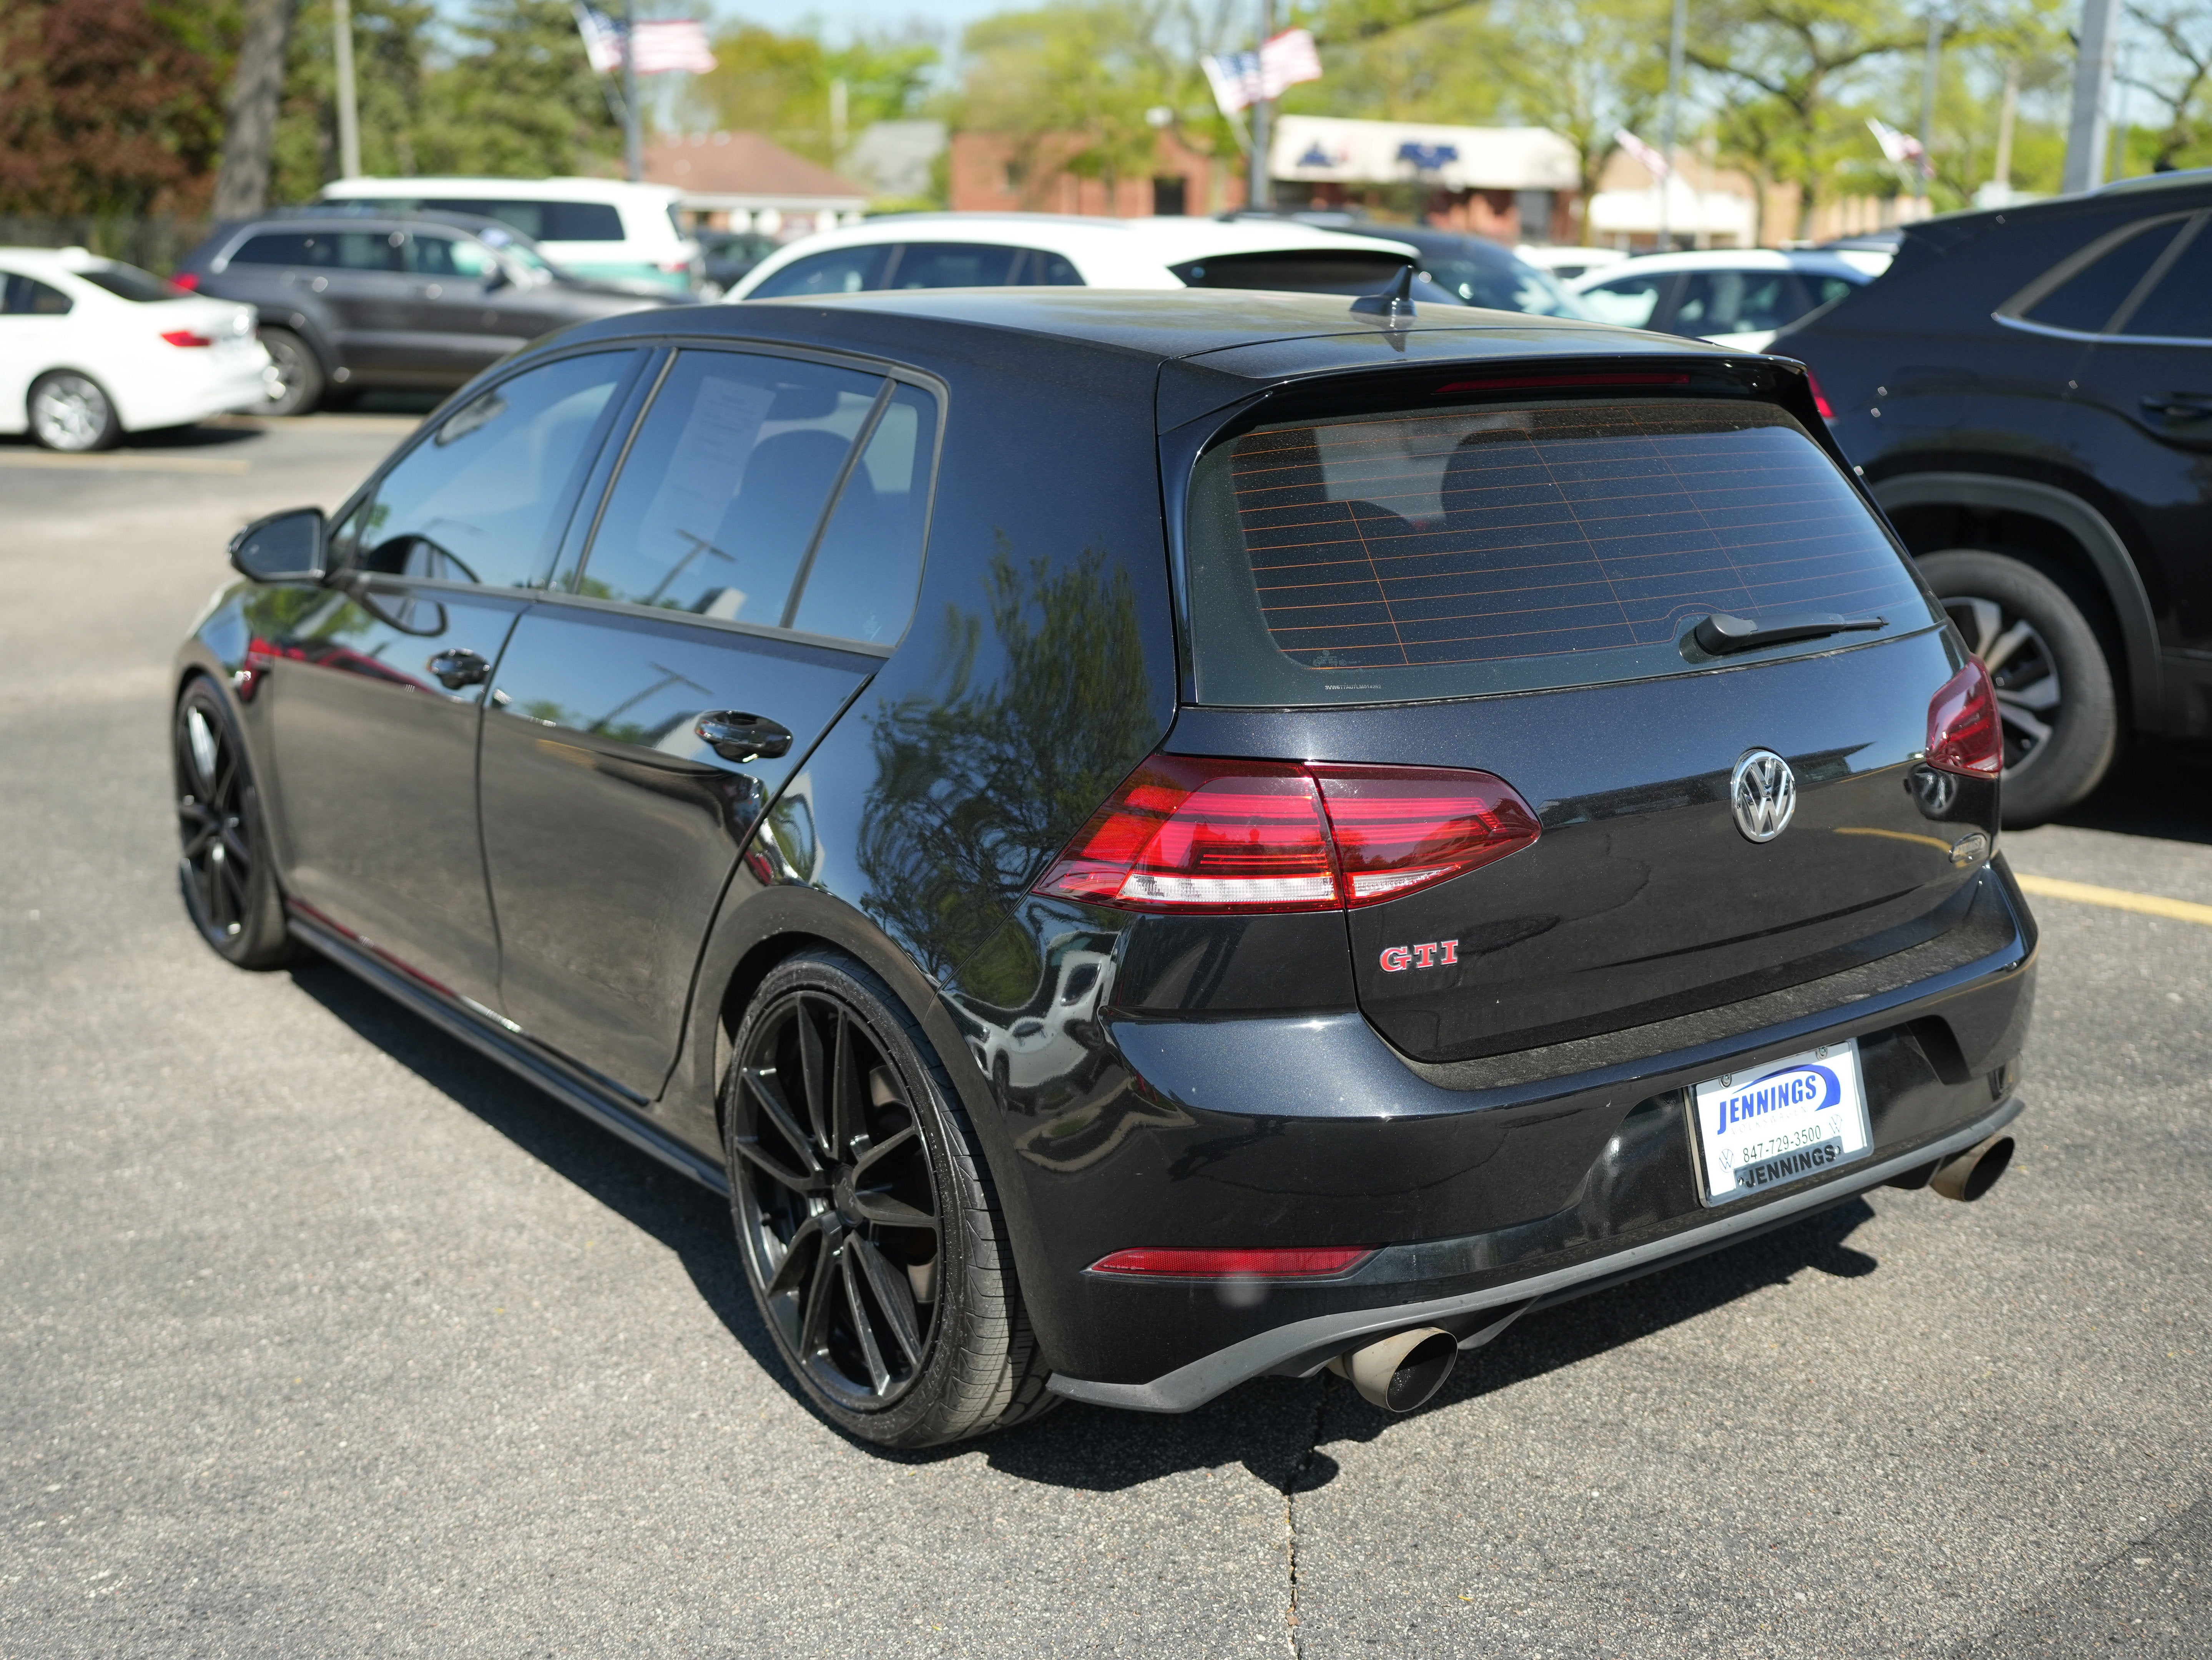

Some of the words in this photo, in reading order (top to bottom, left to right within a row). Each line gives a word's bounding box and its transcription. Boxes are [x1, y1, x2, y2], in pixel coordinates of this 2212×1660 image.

[1733, 749, 1794, 842] VW
[1379, 939, 1458, 973] GTI
[1717, 1075, 1816, 1135] JENNINGS
[1743, 1125, 1821, 1163] 847-729-3500
[1745, 1144, 1836, 1188] JENNINGS
